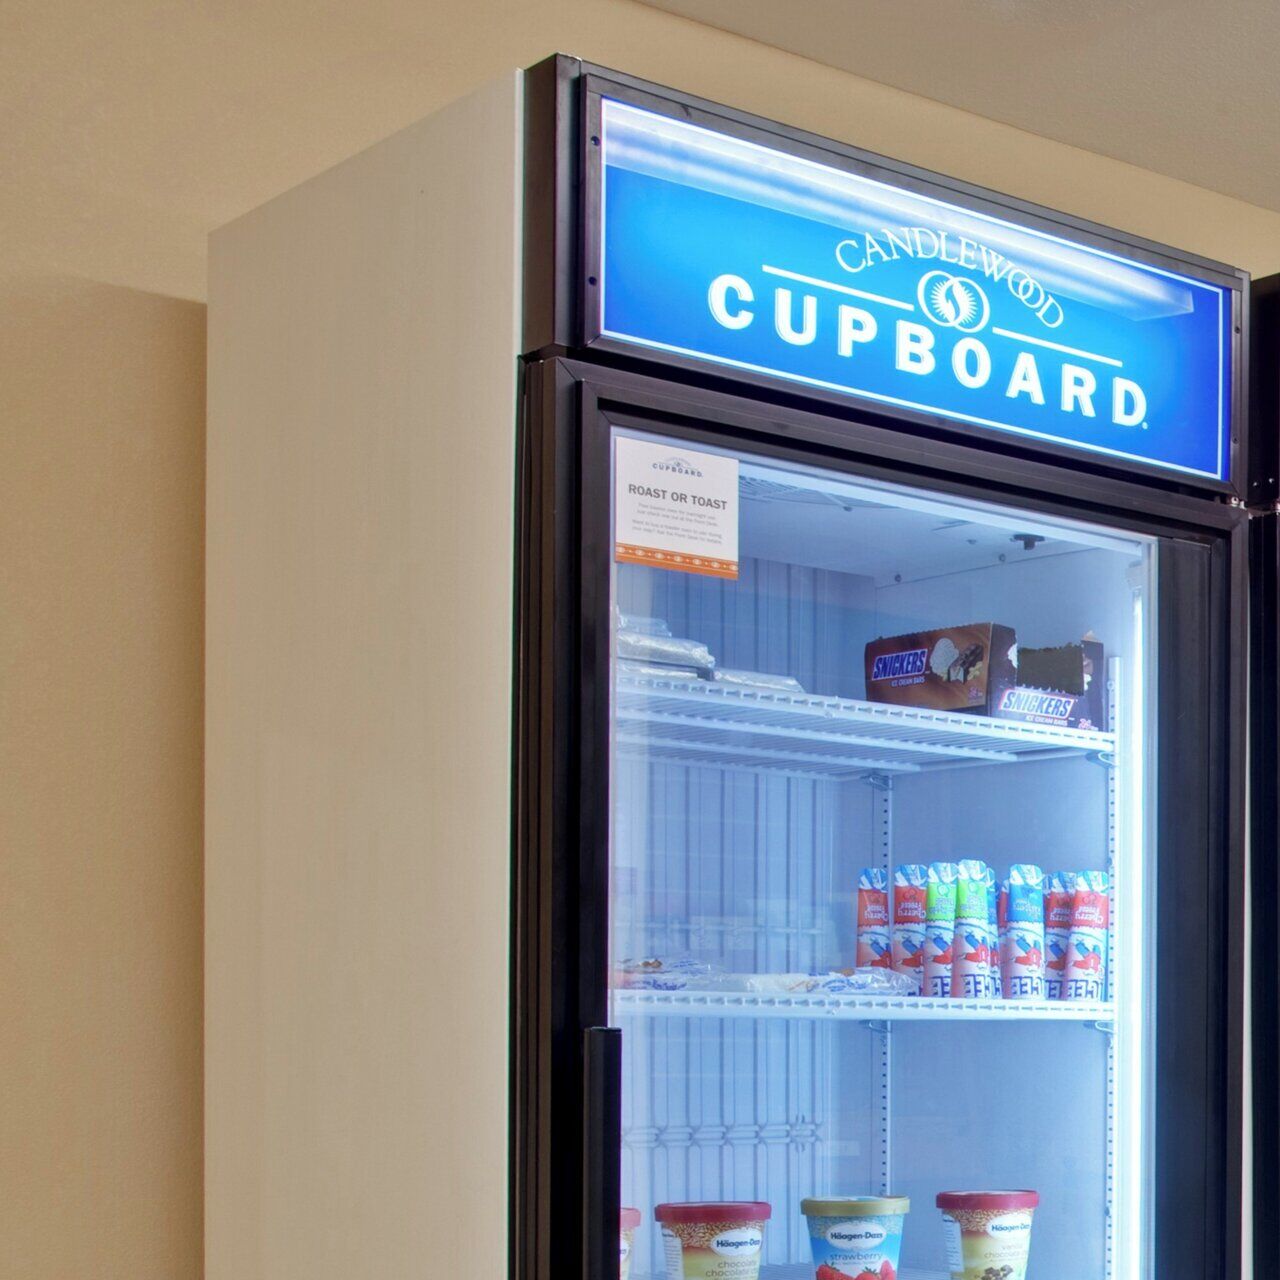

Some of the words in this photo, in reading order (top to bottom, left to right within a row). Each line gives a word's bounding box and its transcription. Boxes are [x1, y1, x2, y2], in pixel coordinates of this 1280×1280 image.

[835, 226, 1065, 329] CANDLEWOOD
[708, 273, 1149, 429] CUPBOARD
[652, 463, 703, 477] CUPBOARD
[628, 483, 667, 500] ROAST
[671, 491, 687, 504] OR
[691, 495, 727, 510] TOAST
[872, 650, 927, 680] SNICKERS
[1003, 691, 1072, 718] SNICKERS
[830, 1252, 883, 1262] strawberry
